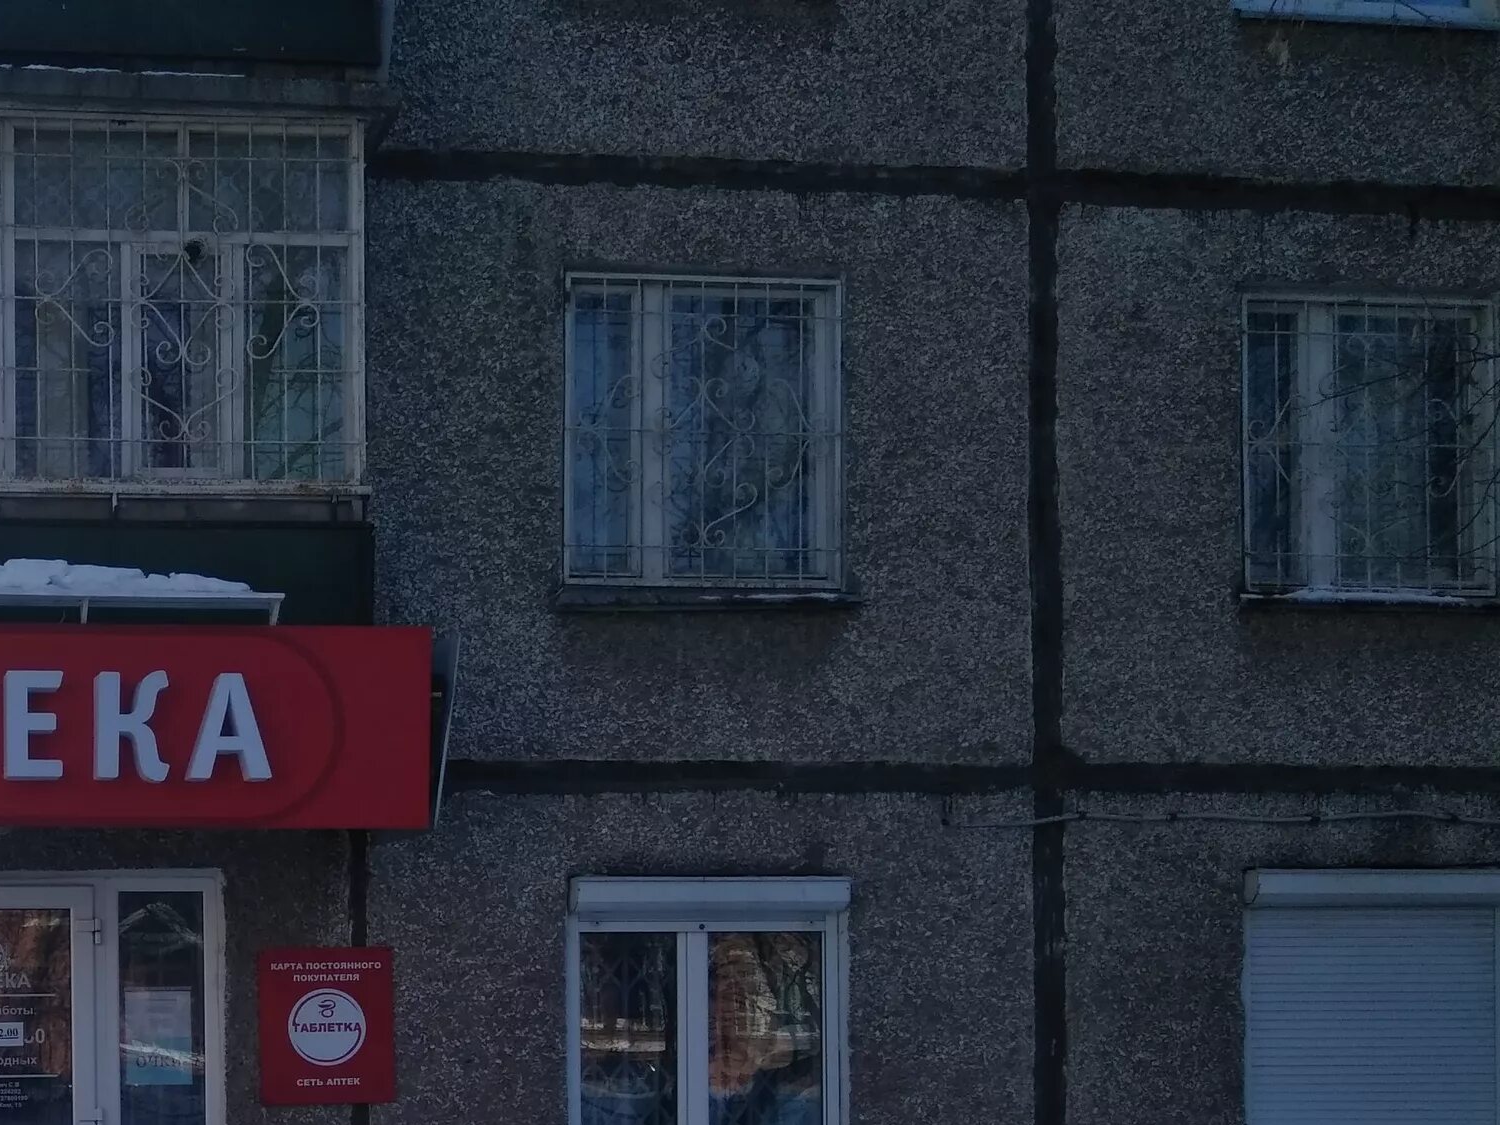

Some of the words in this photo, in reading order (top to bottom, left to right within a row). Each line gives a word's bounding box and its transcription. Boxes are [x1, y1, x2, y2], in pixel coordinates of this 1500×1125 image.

[270, 962, 303, 971] КАРТА
[305, 961, 382, 970] ПОСТОЯННОГО
[293, 974, 360, 982] ПОКУПАТЕЛЯ
[293, 1022, 361, 1033] ТАБЛЕТКА
[296, 1079, 323, 1087] СЕТЬ
[326, 1078, 360, 1086] АПТЕК
